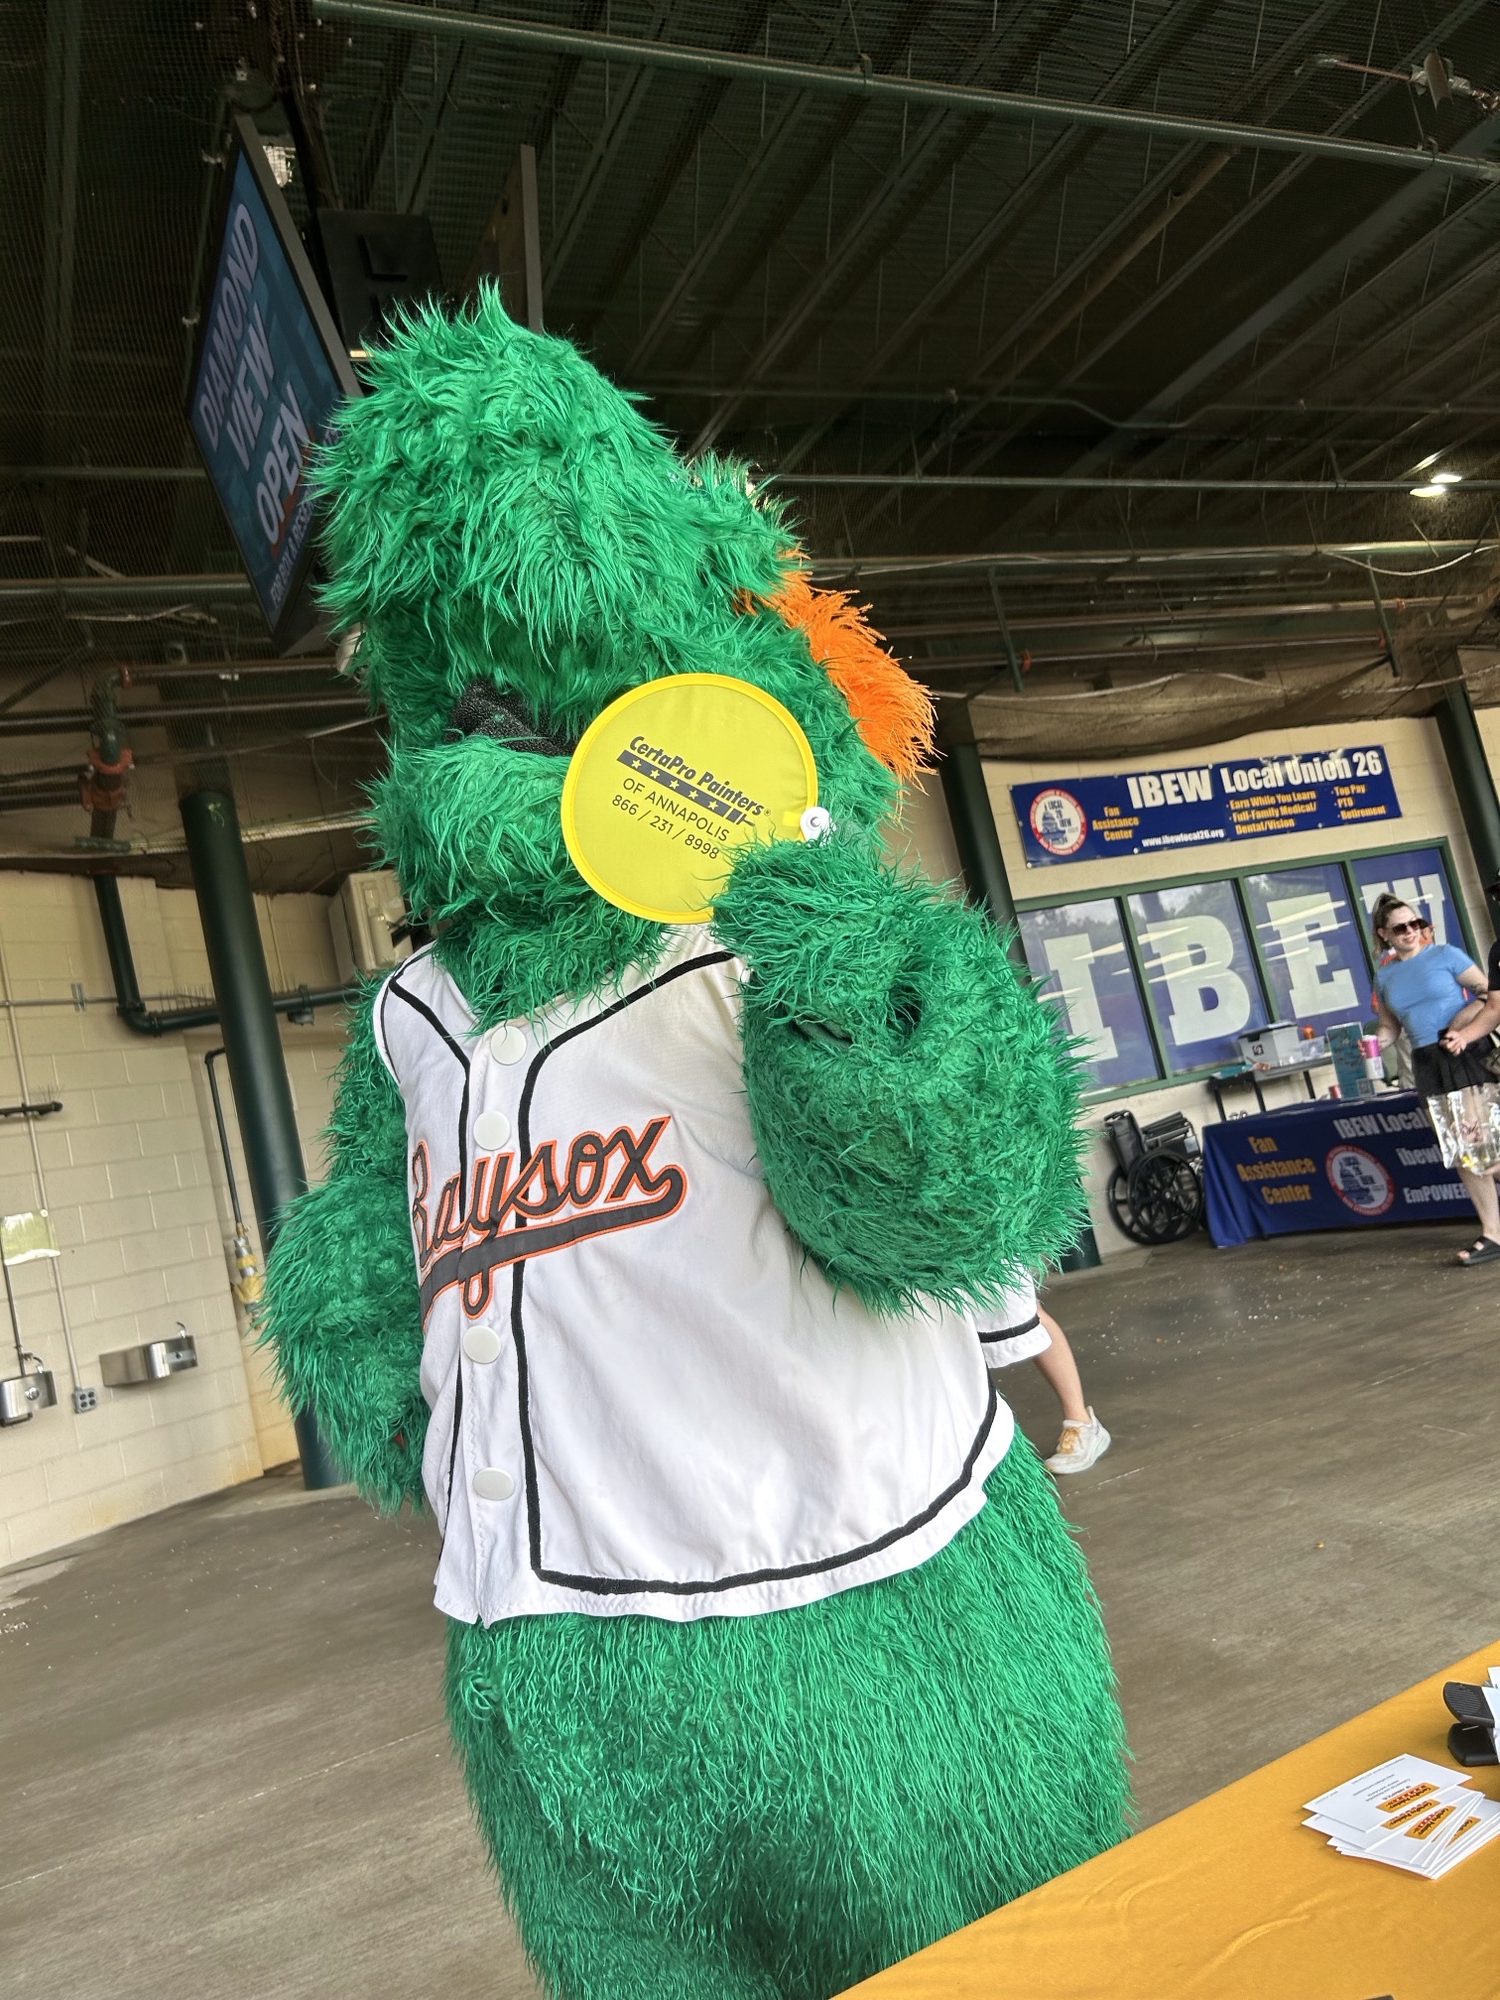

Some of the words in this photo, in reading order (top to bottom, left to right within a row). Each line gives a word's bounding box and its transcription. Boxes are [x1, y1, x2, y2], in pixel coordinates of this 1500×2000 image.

[200, 203, 258, 451] DIAMOND
[226, 301, 275, 471] VIEW
[257, 381, 310, 544] OPEN
[629, 735, 697, 780] CertaPro
[697, 771, 765, 816] Painters
[1126, 768, 1213, 809] IBEW
[1220, 763, 1285, 793] Local
[1285, 754, 1353, 786] Union
[1352, 750, 1383, 776] 26
[1230, 799, 1250, 810] Earn
[1250, 795, 1276, 807] While
[1276, 793, 1292, 804] You
[1292, 790, 1317, 801] Learn
[1334, 786, 1350, 797] Top
[1350, 784, 1366, 794] Pay
[623, 778, 646, 794] OF
[644, 791, 730, 842] ANNAPOLIS
[1104, 806, 1120, 818] Fan
[1337, 796, 1353, 808] PTO
[1232, 807, 1280, 823] Full-Family
[1340, 805, 1386, 820] Retirement
[611, 794, 640, 816] 866
[637, 809, 652, 821] /
[649, 815, 674, 835] 231
[671, 828, 686, 840] /
[684, 834, 720, 859] 8998
[1092, 816, 1139, 831] Assistance
[1235, 818, 1295, 835] Dental/Vision
[1103, 829, 1133, 842] Center
[1142, 828, 1224, 847] www.ibewlocal26.org
[1333, 1114, 1380, 1139] IBEW
[1377, 1107, 1429, 1134] Local
[1248, 1136, 1278, 1154] Fan
[1236, 1157, 1317, 1182] Assistance
[1260, 1184, 1313, 1205] Center
